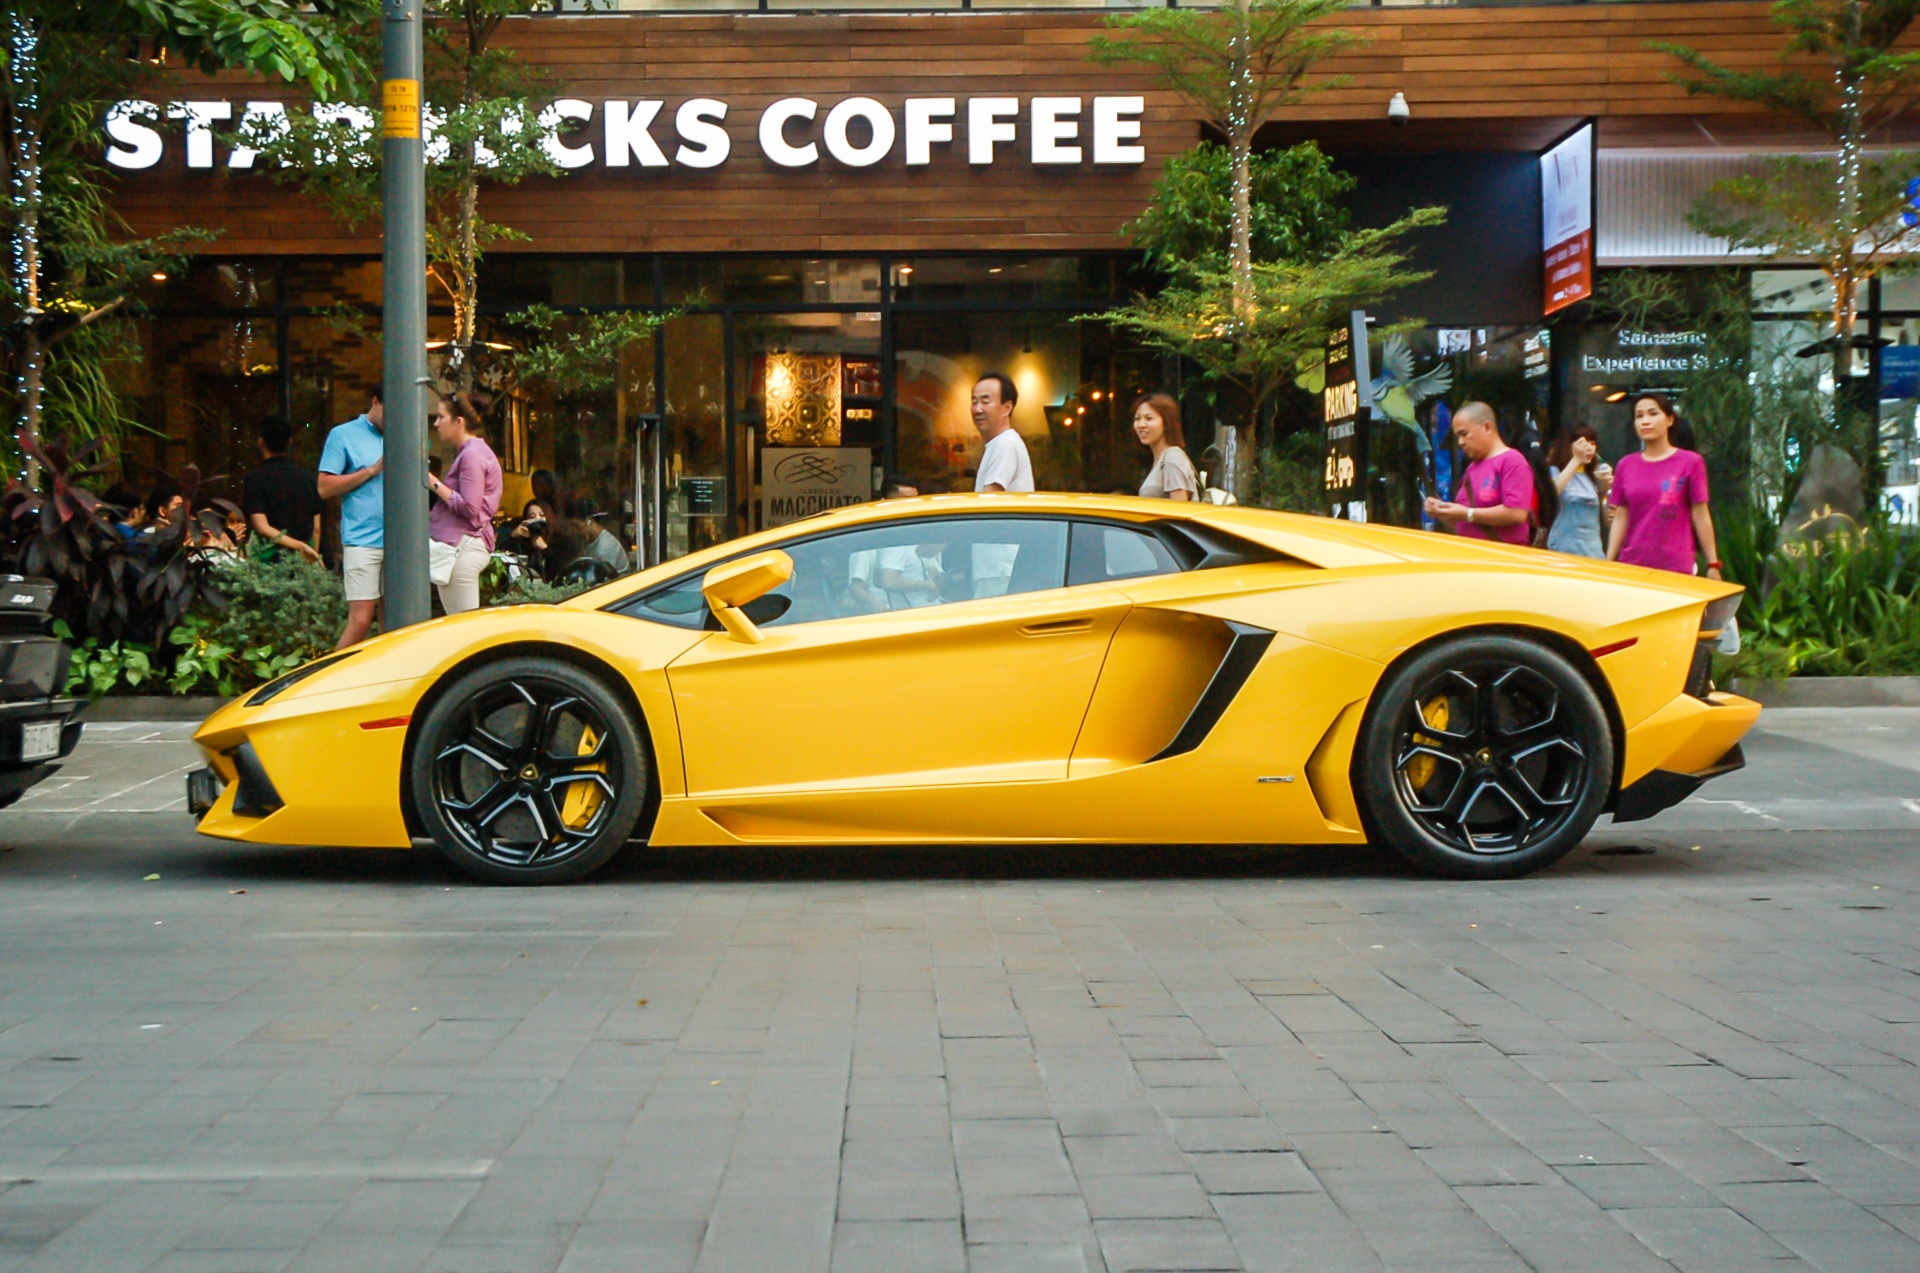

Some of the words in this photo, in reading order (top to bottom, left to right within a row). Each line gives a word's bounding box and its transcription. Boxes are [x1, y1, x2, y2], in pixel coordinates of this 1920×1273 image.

[758, 97, 1145, 167] COFFEE
[1583, 354, 1689, 373] Experience
[1324, 381, 1357, 423] PARKING
